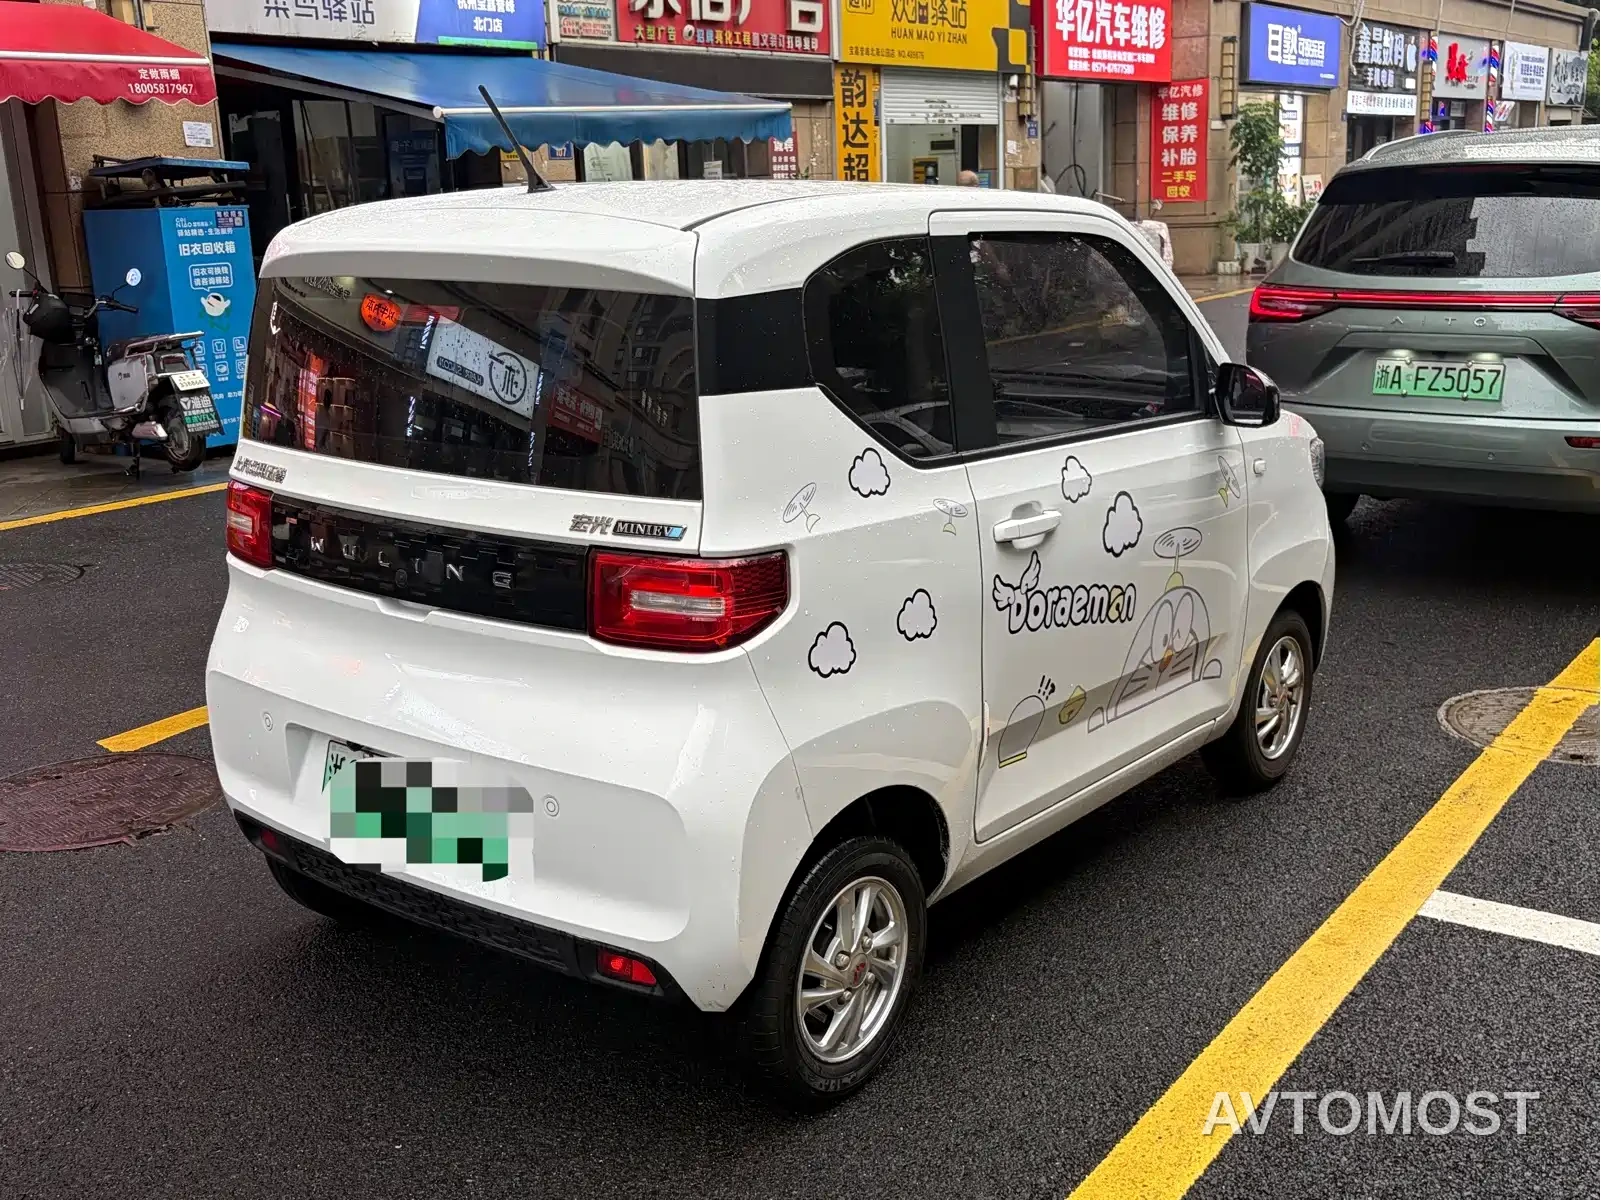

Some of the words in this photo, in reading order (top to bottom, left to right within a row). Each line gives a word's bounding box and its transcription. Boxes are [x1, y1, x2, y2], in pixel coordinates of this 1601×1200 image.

[473, 16, 503, 33] 北门店
[634, 24, 676, 41] 大型广告
[1055, 0, 1166, 50] 华亿汽车维修
[891, 27, 914, 39] HUAN
[916, 30, 935, 42] MAO
[937, 31, 945, 42] YI
[947, 32, 967, 44] ZHAN
[138, 68, 180, 80] 定做雨棚
[128, 83, 194, 95] 18005817967
[1158, 84, 1203, 99] 华亿汽修
[1162, 102, 1199, 121] 维修
[1162, 124, 1198, 144] 保养
[1161, 147, 1197, 167] 补胎
[1161, 170, 1197, 183] 二手车
[1166, 185, 1191, 198] 回收
[178, 241, 236, 256] 旧衣回收箱
[1375, 365, 1401, 390] 浙A
[1413, 366, 1501, 395] FZ5057
[191, 394, 213, 409] 雅迪
[569, 513, 613, 535] 宏光
[1007, 583, 1137, 634] Doraemon
